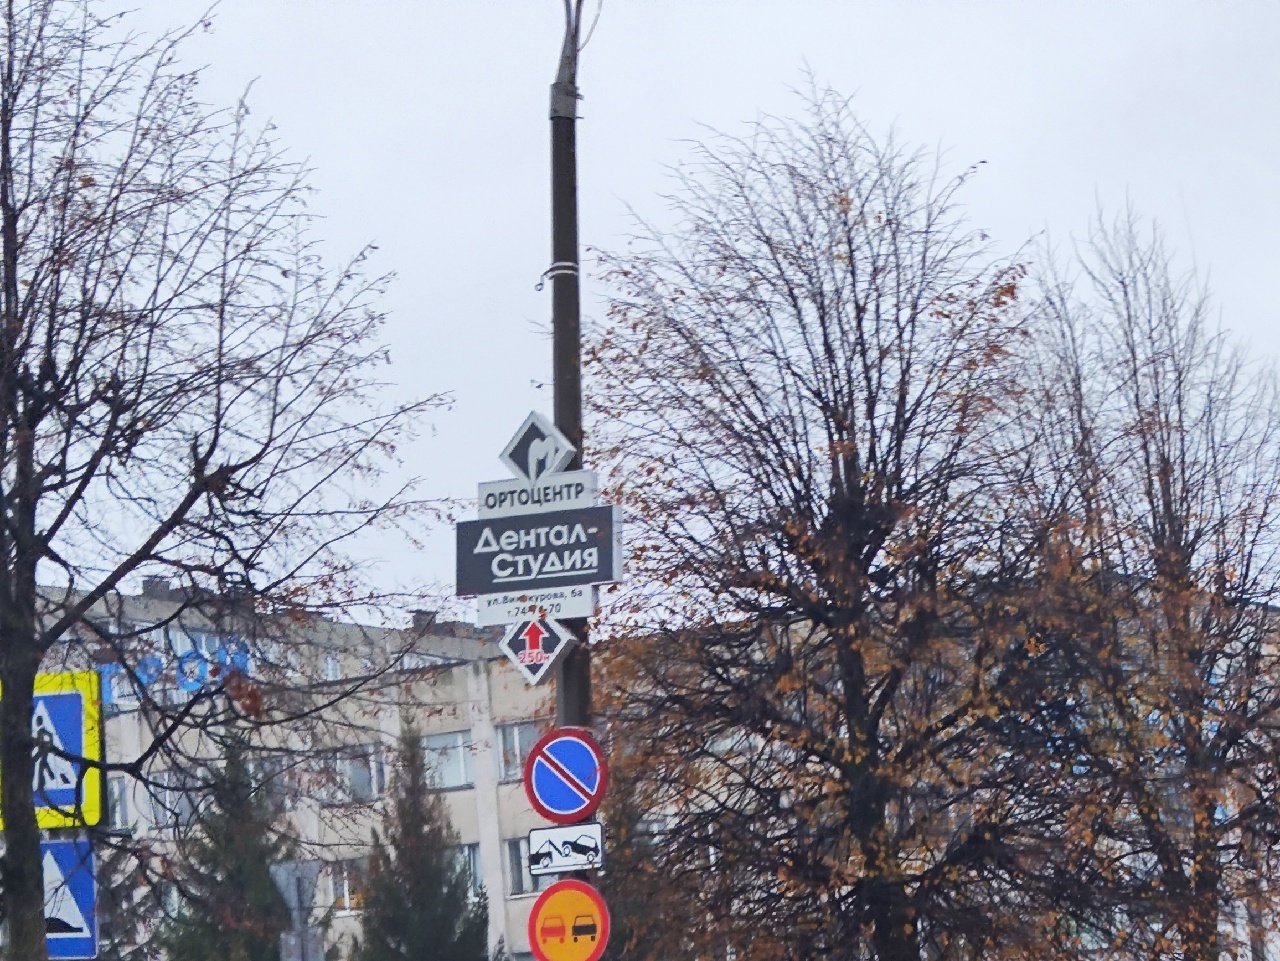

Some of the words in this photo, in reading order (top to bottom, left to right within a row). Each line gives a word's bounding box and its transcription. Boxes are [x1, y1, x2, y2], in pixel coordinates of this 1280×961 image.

[485, 482, 585, 509] ОРТОЦЕНТР
[473, 523, 599, 554] Дентал-
[491, 547, 599, 580] Студия
